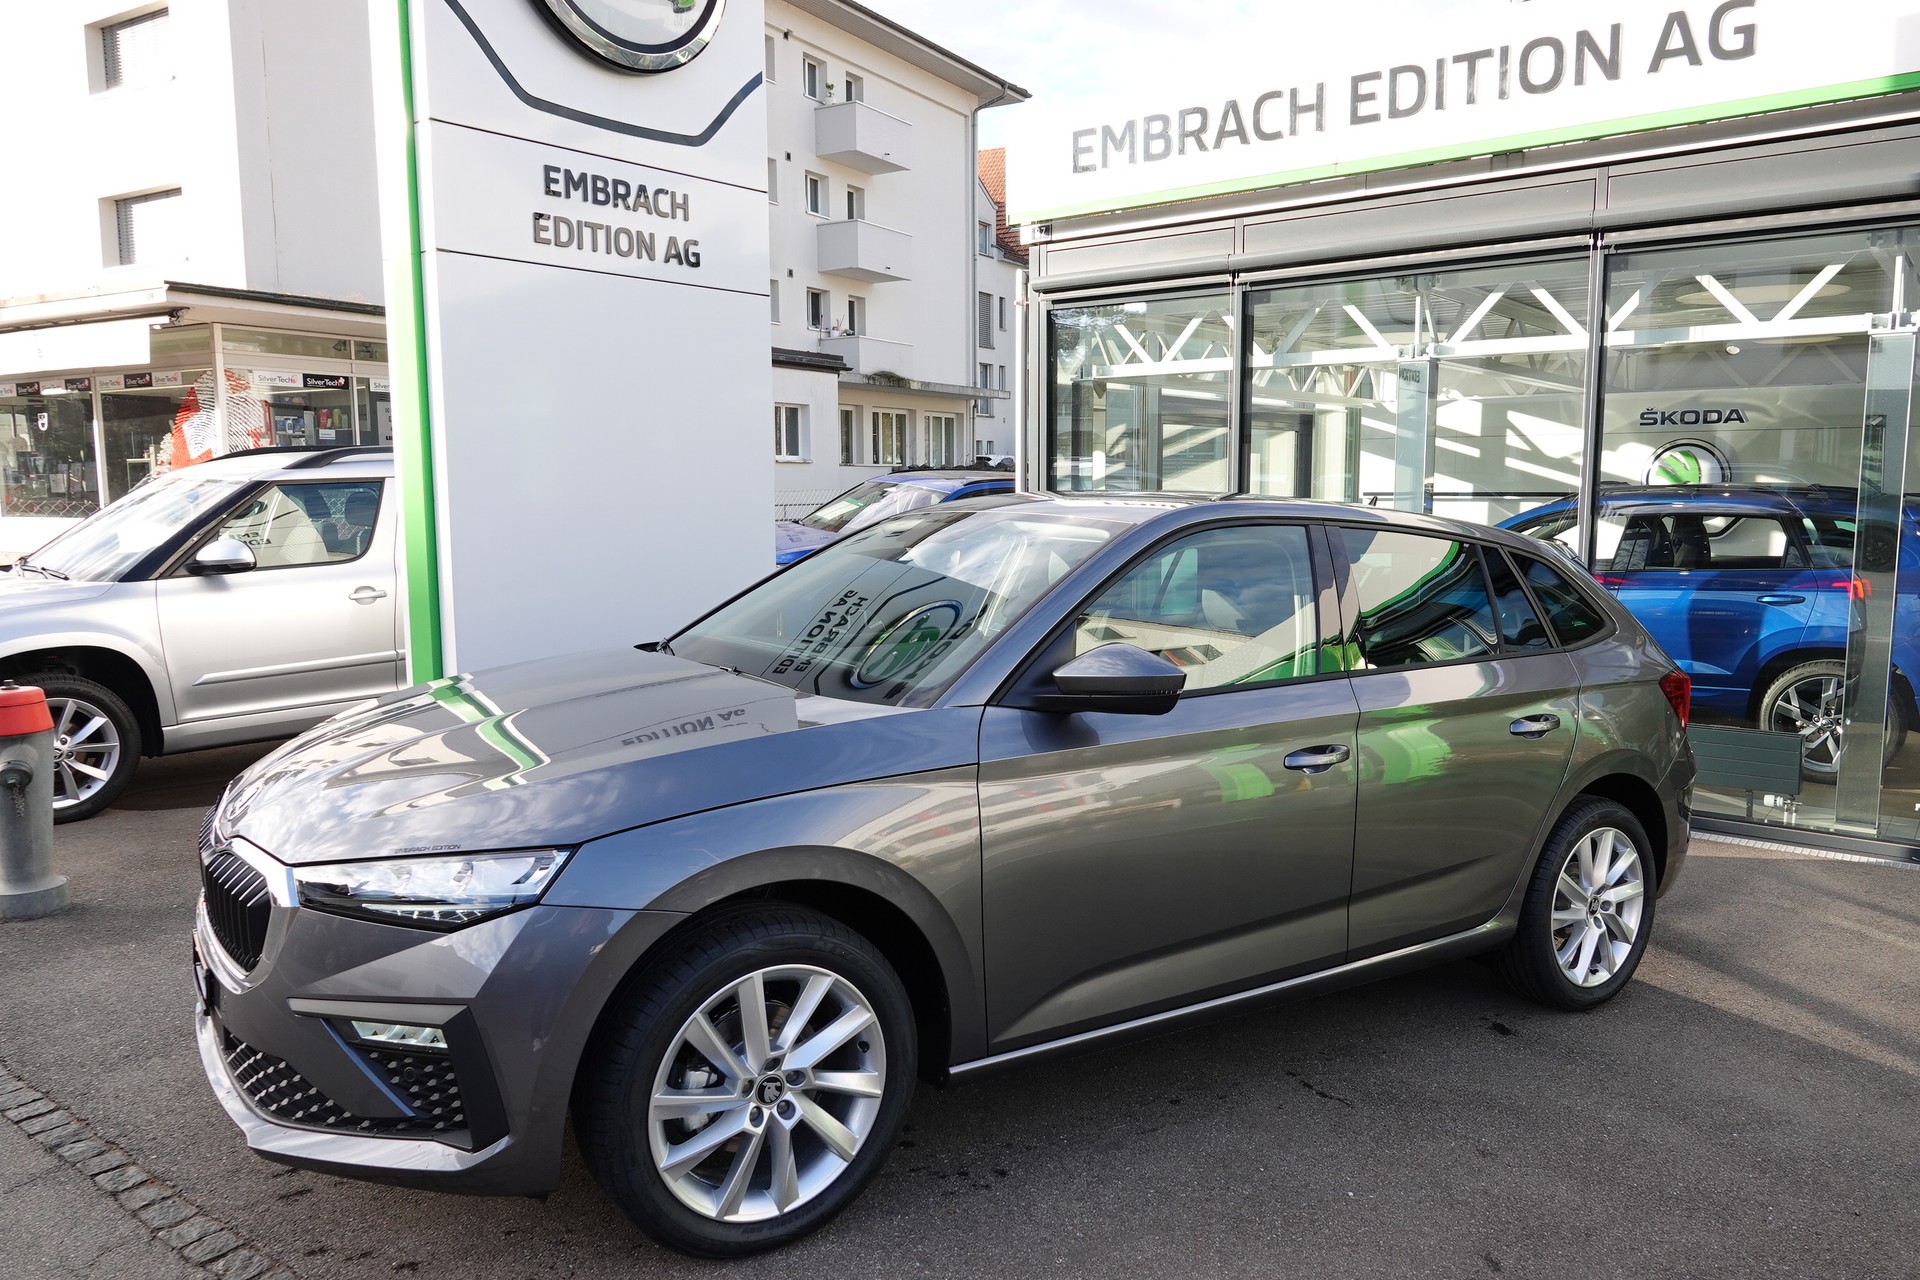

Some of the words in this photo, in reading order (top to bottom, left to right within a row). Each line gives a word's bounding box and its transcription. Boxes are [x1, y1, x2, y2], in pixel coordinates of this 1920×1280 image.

[1072, 82, 1326, 174] EMBRACH
[1350, 23, 1622, 125] EDITION
[1647, 0, 1757, 74] AG
[543, 164, 689, 222] EMBRACH
[532, 212, 656, 261] EDITION
[663, 235, 701, 268] AG
[1638, 406, 1747, 427] ŠKODA
